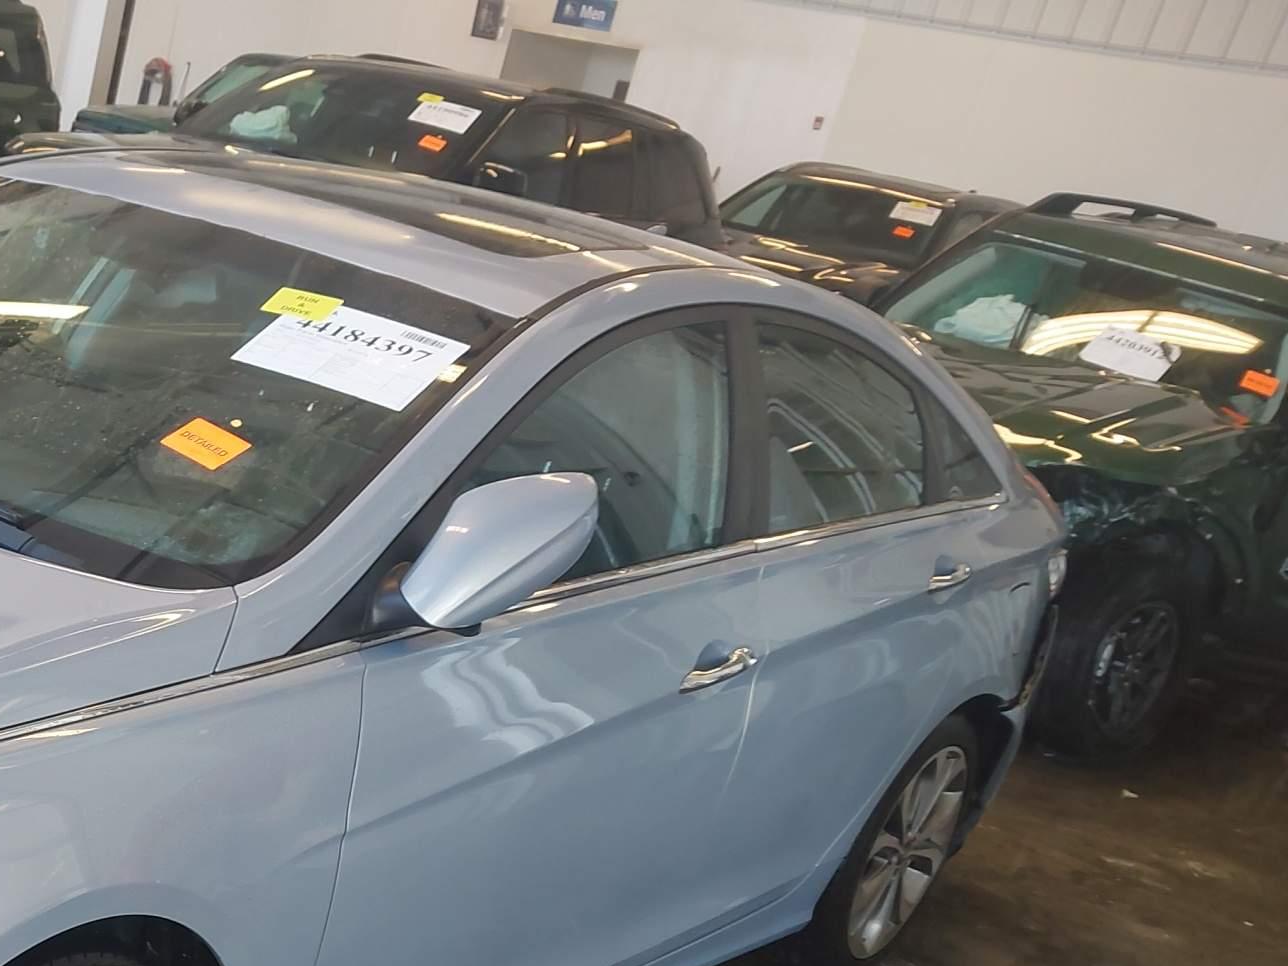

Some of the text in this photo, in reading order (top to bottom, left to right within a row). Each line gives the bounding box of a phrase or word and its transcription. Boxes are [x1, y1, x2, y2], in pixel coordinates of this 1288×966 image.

[579, 4, 607, 22] Men
[296, 319, 433, 362] 44184397
[179, 430, 229, 458] DETAILED
